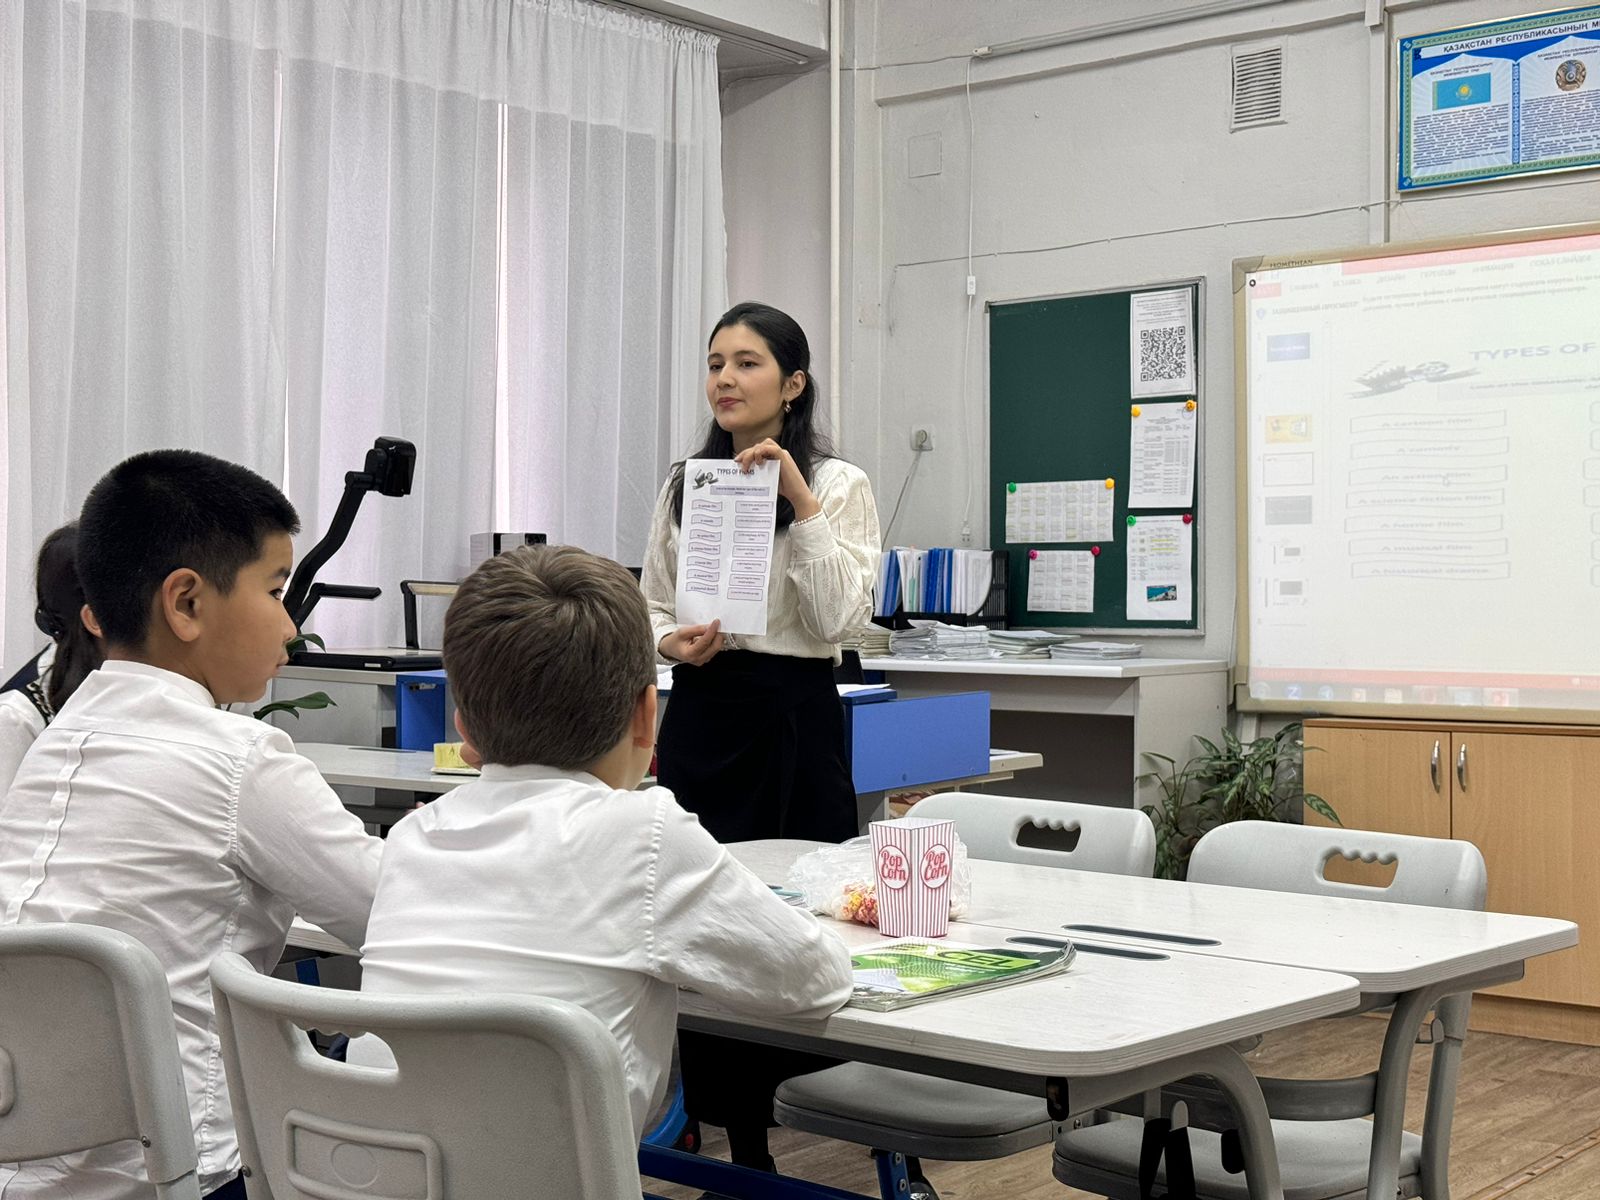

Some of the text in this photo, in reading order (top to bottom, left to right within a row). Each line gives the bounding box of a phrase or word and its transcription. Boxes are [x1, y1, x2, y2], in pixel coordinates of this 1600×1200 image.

[1592, 20, 1600, 29] М
[1469, 342, 1597, 361] TYPES OF
[881, 850, 903, 870] Pop
[926, 851, 946, 867] Pop
[881, 863, 906, 880] Corn
[924, 864, 948, 881] Corn
